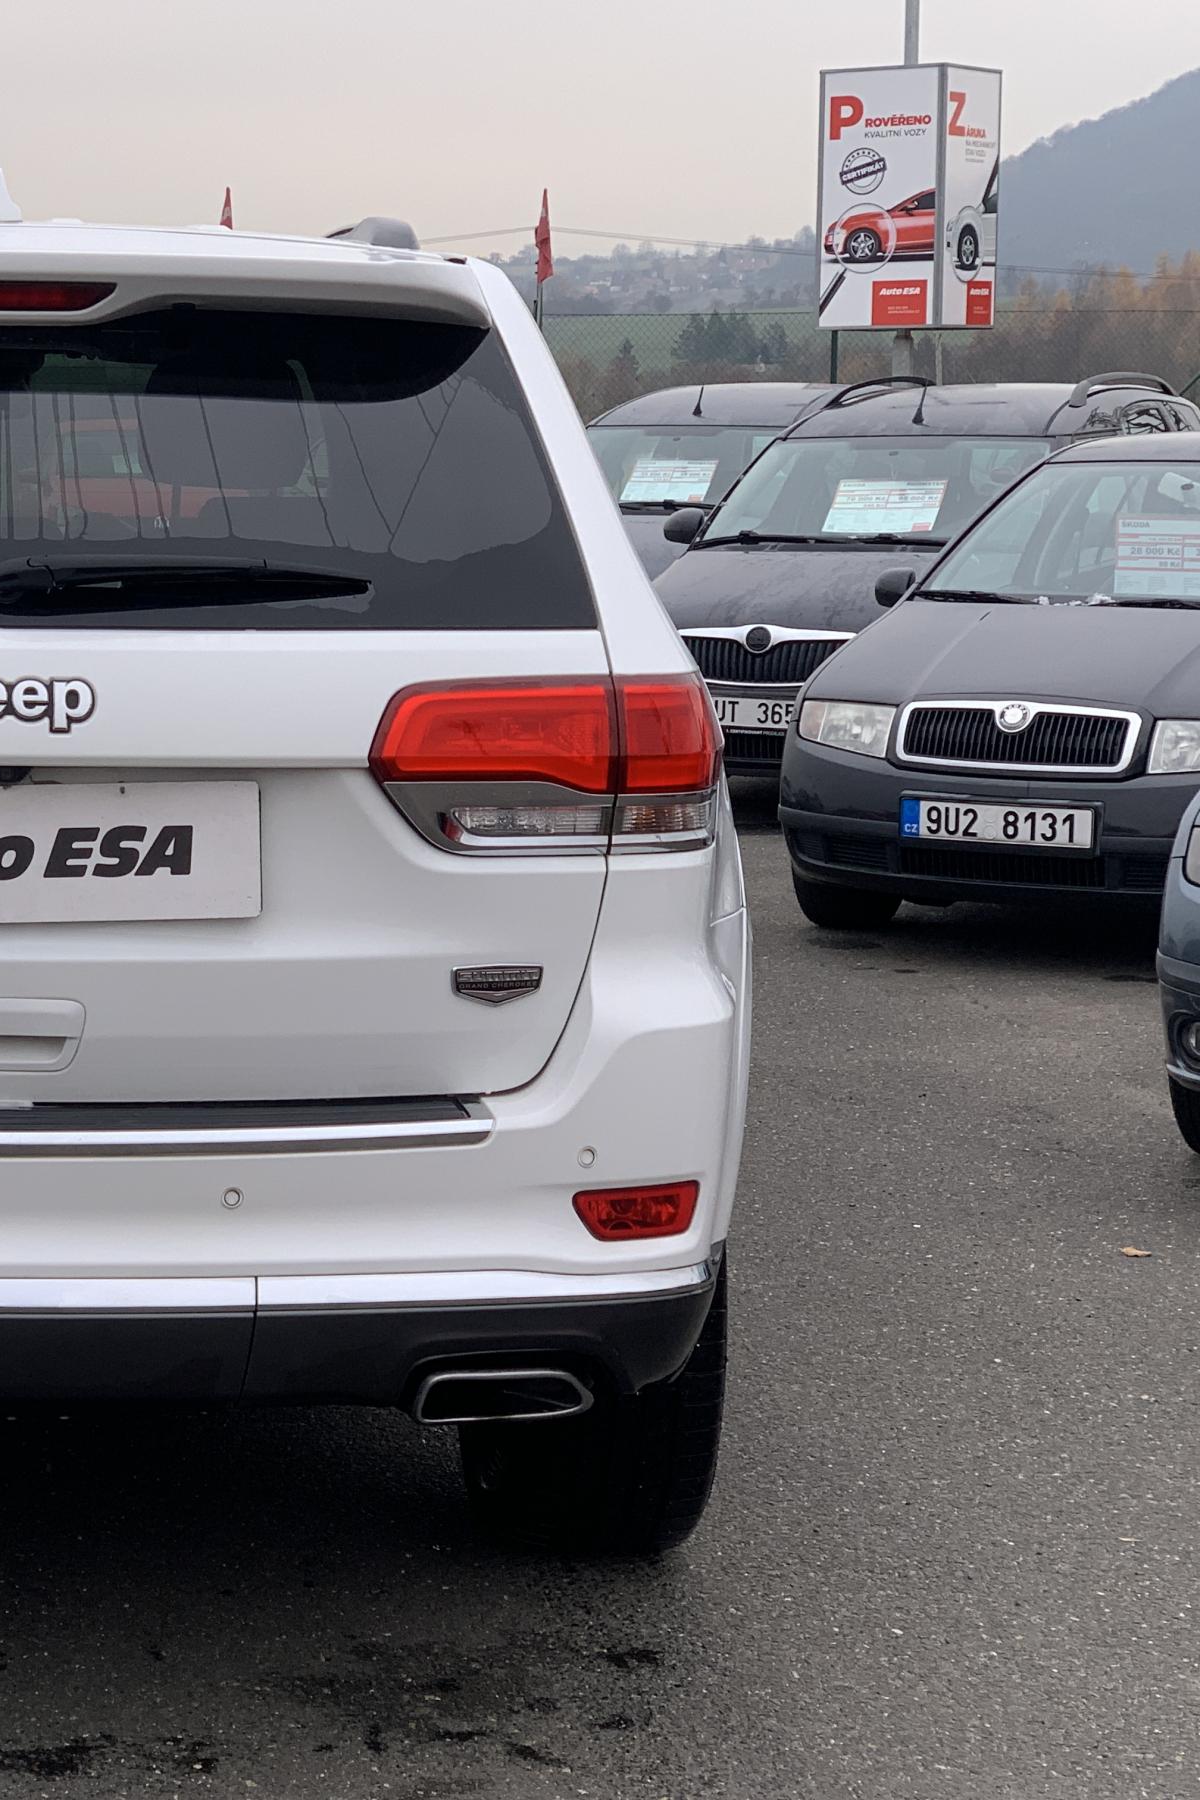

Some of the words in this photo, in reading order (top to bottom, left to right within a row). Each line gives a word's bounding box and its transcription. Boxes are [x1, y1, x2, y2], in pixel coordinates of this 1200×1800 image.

[864, 128, 901, 139] KVALITNÍ
[903, 128, 927, 137] VOZY
[879, 286, 903, 296] Auto
[903, 286, 921, 295] ESA
[903, 823, 918, 833] CZ
[926, 805, 978, 838] 9U2
[1002, 810, 1076, 843] 8131
[43, 825, 194, 878] ESA
